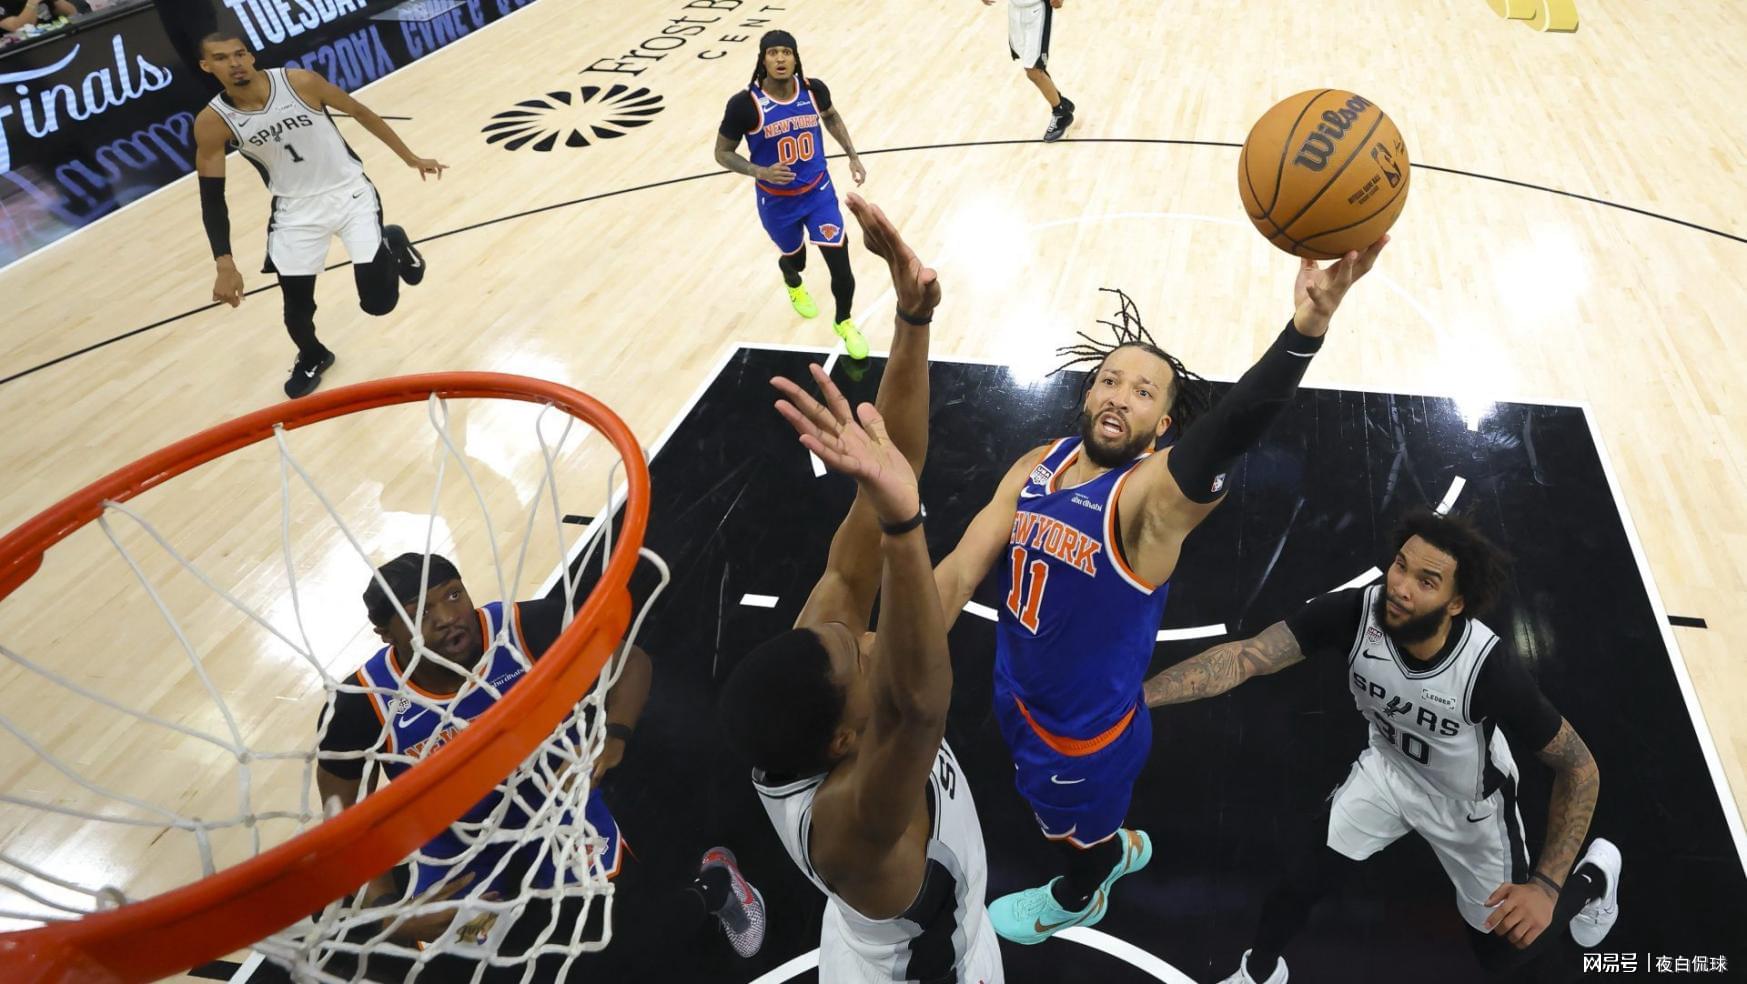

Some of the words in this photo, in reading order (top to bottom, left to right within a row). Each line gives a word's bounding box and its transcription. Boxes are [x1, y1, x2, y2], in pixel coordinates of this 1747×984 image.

[223, 0, 367, 51] TUES
[578, 16, 721, 77] Frost
[249, 114, 313, 147] SPURS
[763, 118, 791, 139] NEW
[789, 114, 818, 131] YORK
[777, 131, 815, 165] 00
[1293, 95, 1373, 172] Wilson
[284, 143, 304, 163] 1
[1009, 511, 1039, 546] EW
[1031, 513, 1103, 578] YORK
[1007, 546, 1049, 635] 11
[1353, 672, 1460, 737] SPURS
[1425, 692, 1451, 705] LEDGER
[1374, 711, 1429, 765] 30
